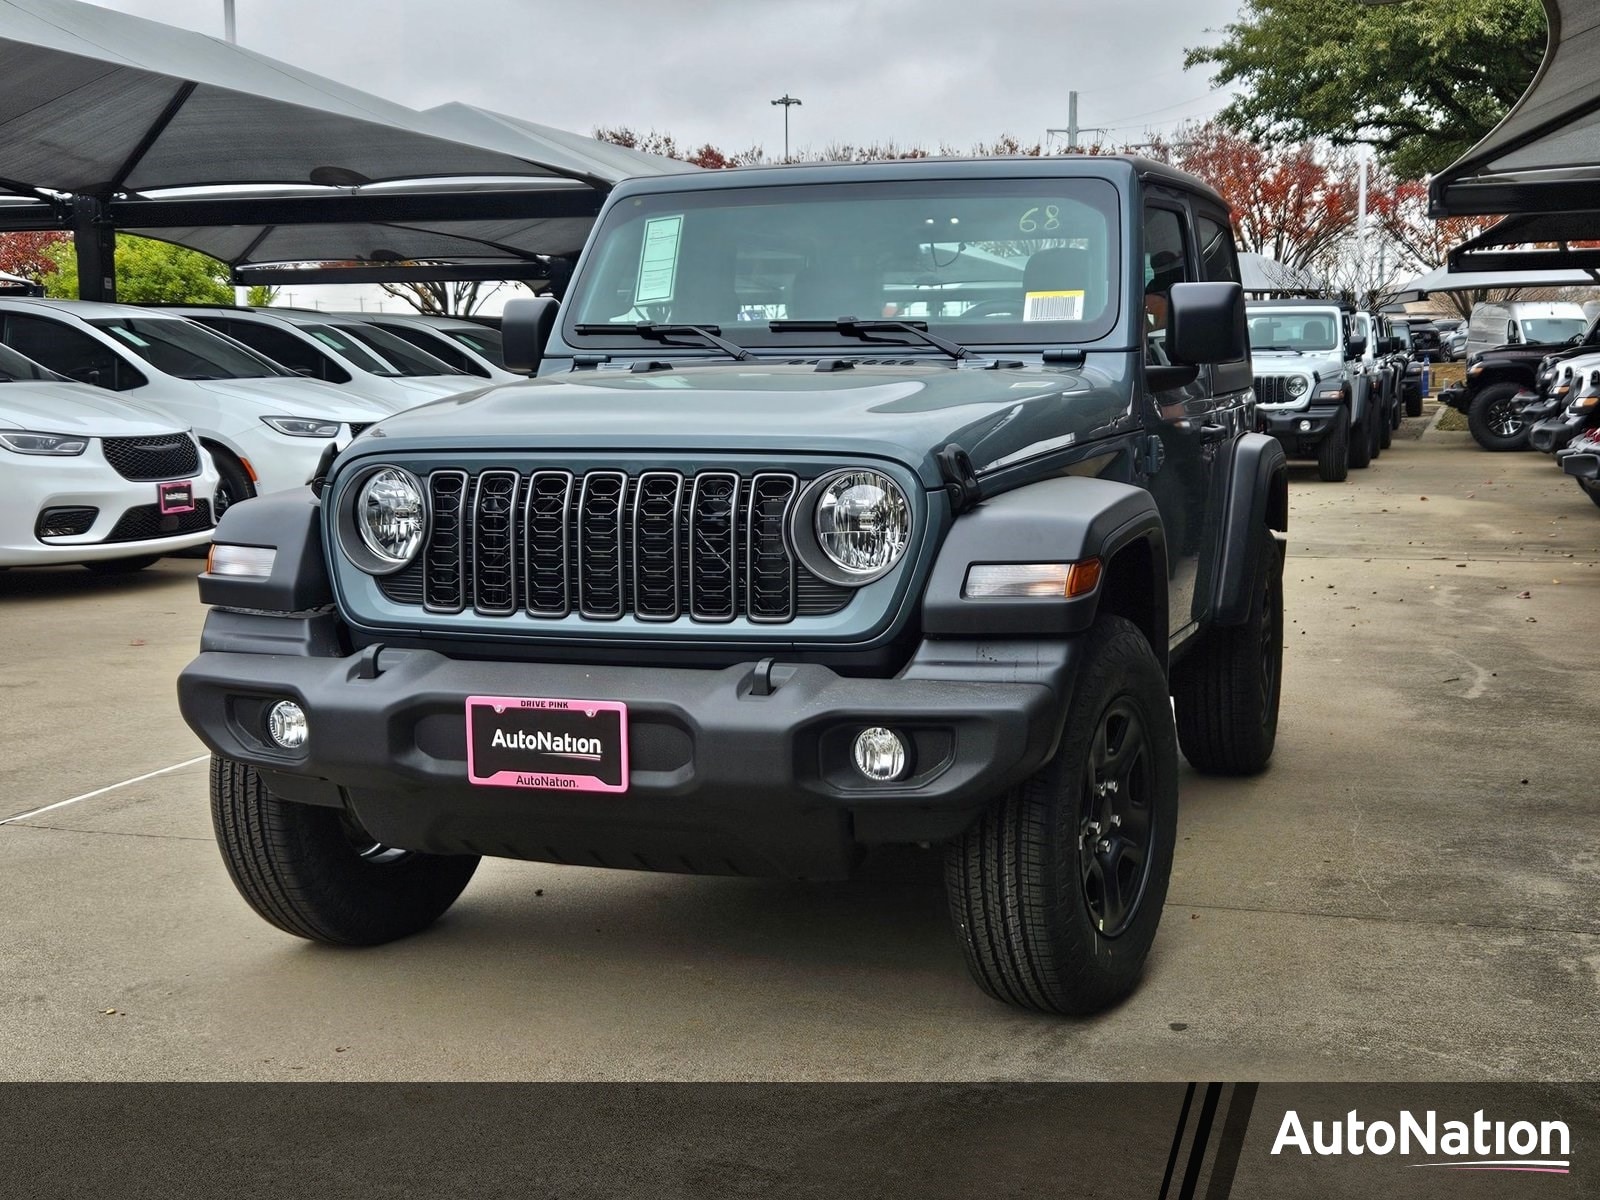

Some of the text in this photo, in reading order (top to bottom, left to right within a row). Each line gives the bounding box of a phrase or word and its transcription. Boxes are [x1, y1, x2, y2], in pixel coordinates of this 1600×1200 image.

[1019, 205, 1060, 232] 68
[520, 700, 569, 709] DRIVE PINK
[491, 728, 602, 754] AutoNation
[516, 775, 576, 788] AutoNation
